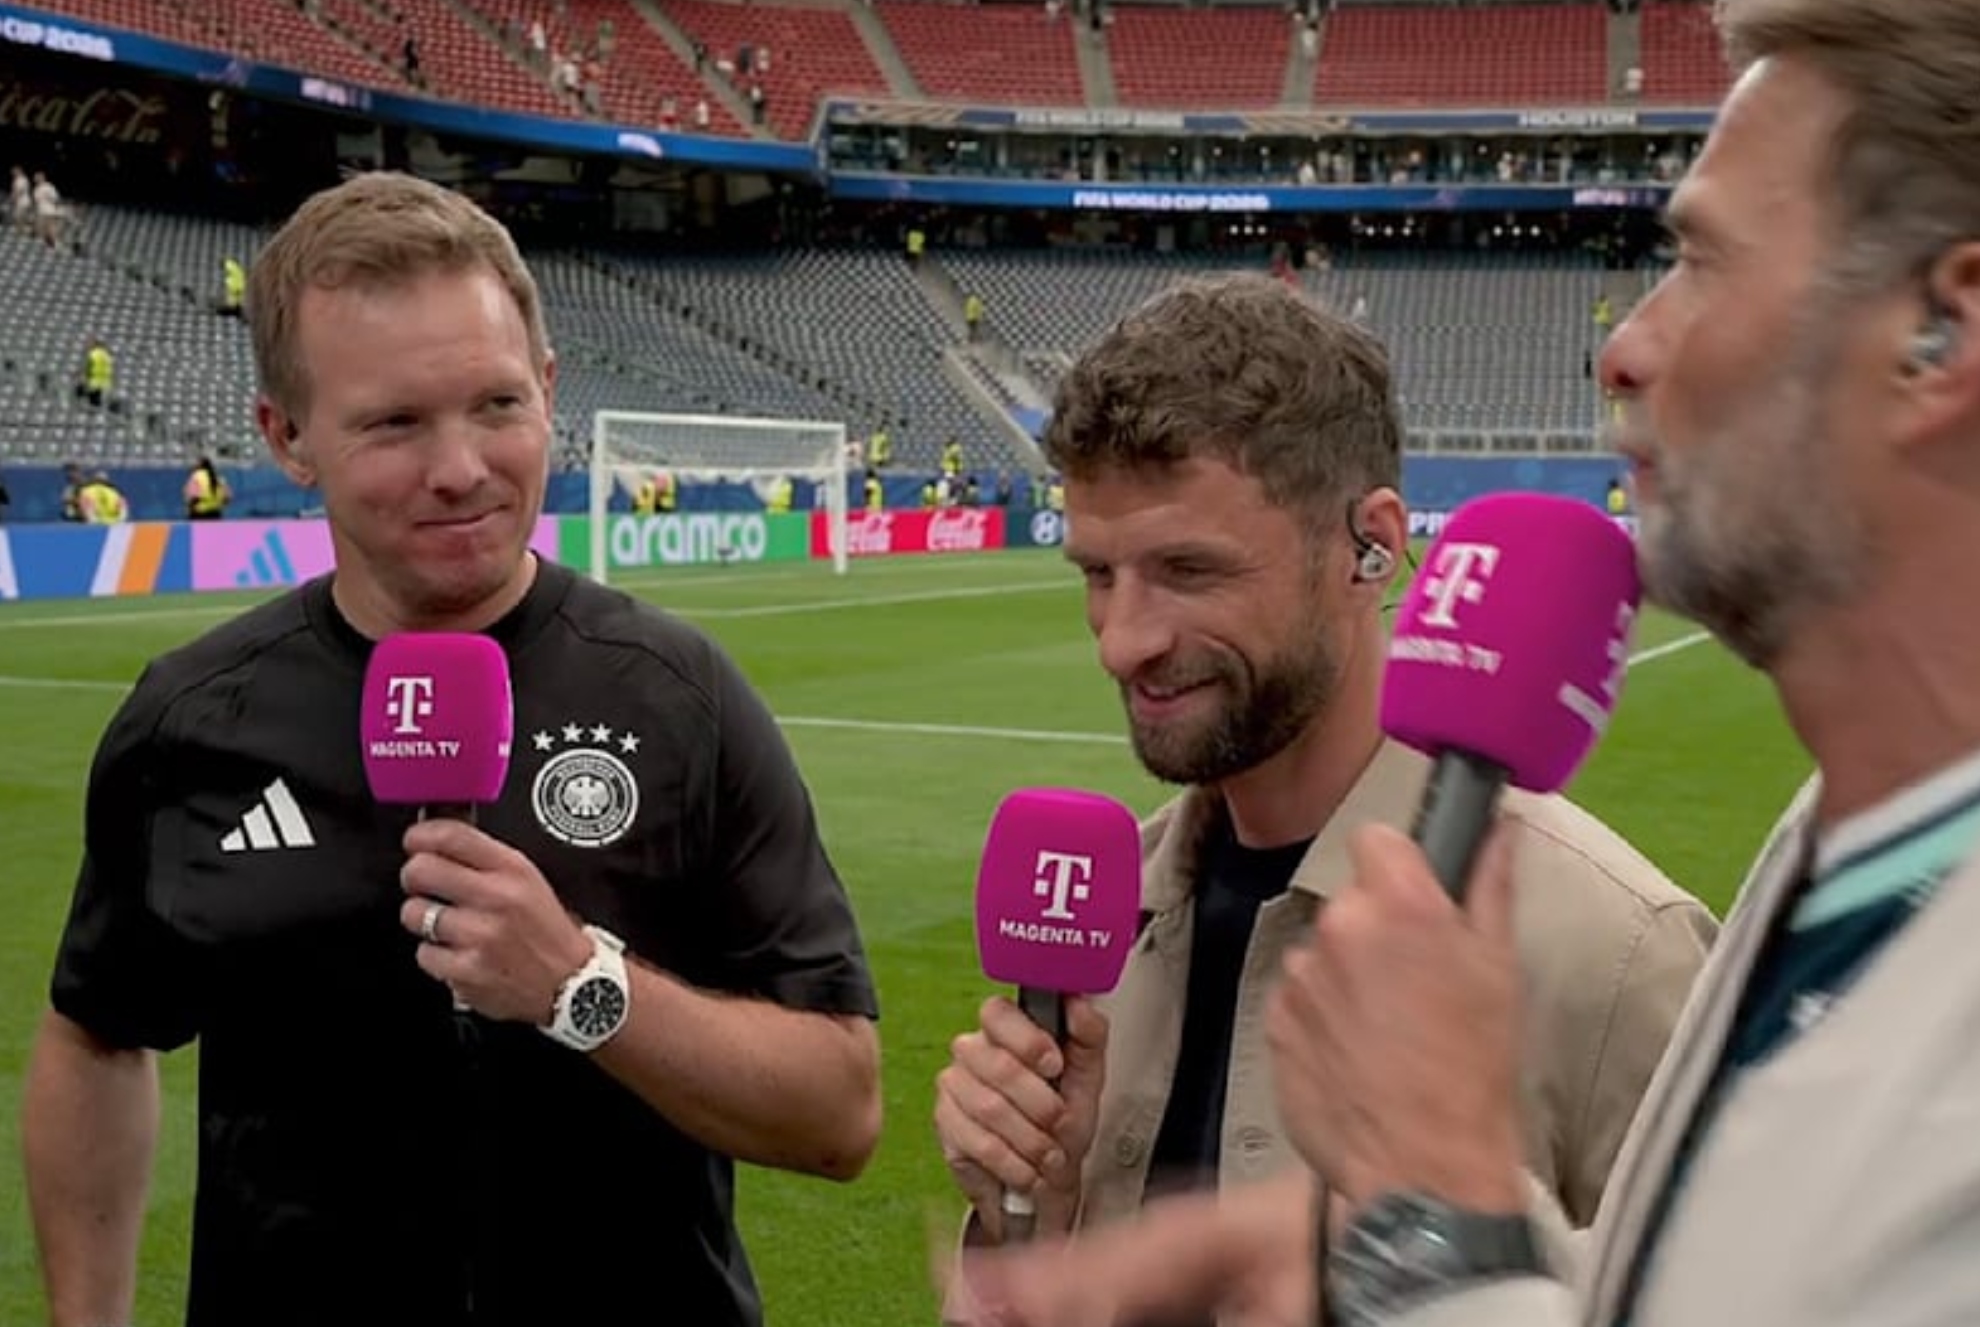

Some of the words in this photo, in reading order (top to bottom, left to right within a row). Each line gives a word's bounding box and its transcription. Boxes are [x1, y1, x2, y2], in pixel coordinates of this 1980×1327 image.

[1074, 191, 1109, 208] FIFA
[612, 514, 766, 565] aramco
[387, 676, 433, 734] T
[370, 741, 435, 757] MAGENTA
[438, 741, 460, 757] TV
[1034, 851, 1092, 920] T
[1000, 919, 1083, 945] MAGENTA
[1089, 930, 1111, 947] TV
